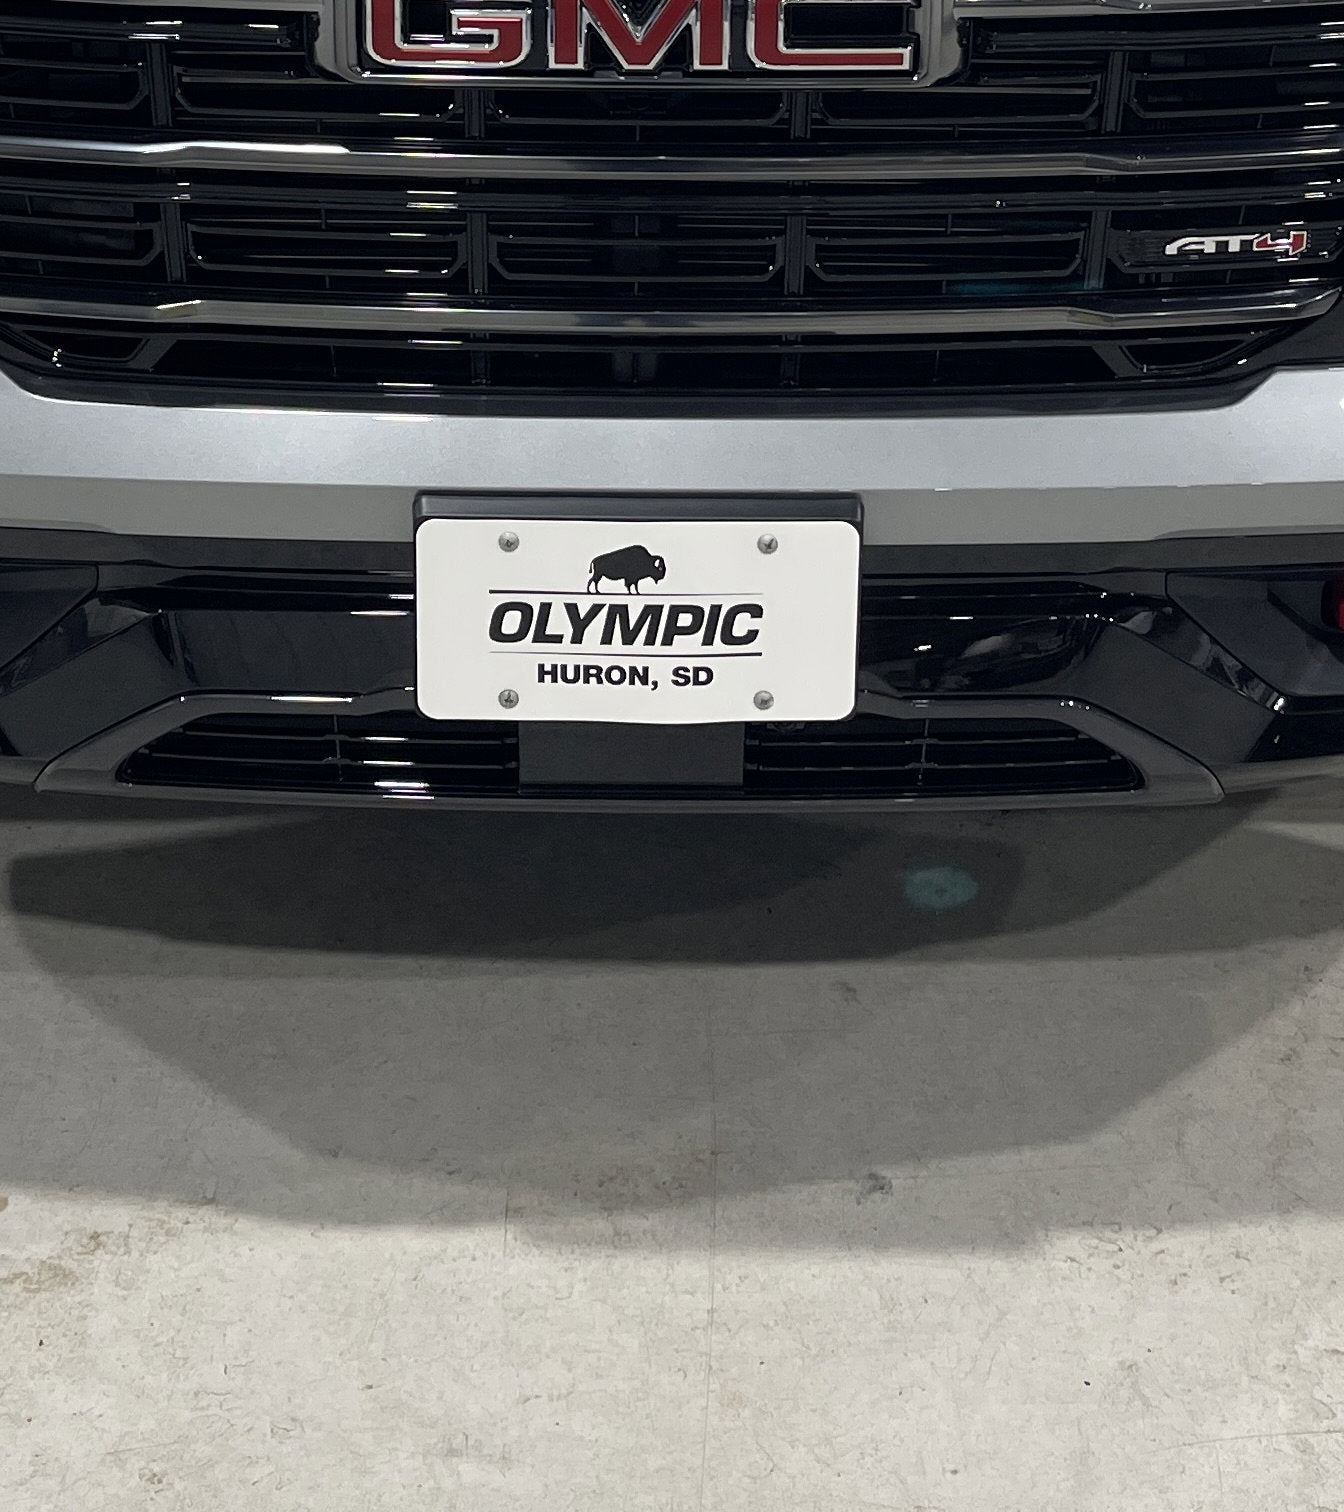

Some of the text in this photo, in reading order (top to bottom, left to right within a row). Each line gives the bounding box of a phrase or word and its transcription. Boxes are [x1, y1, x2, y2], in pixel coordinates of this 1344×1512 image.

[1164, 231, 1308, 256] AT4
[488, 600, 764, 647] OLYMPIC
[537, 663, 714, 691] HURON, SD
